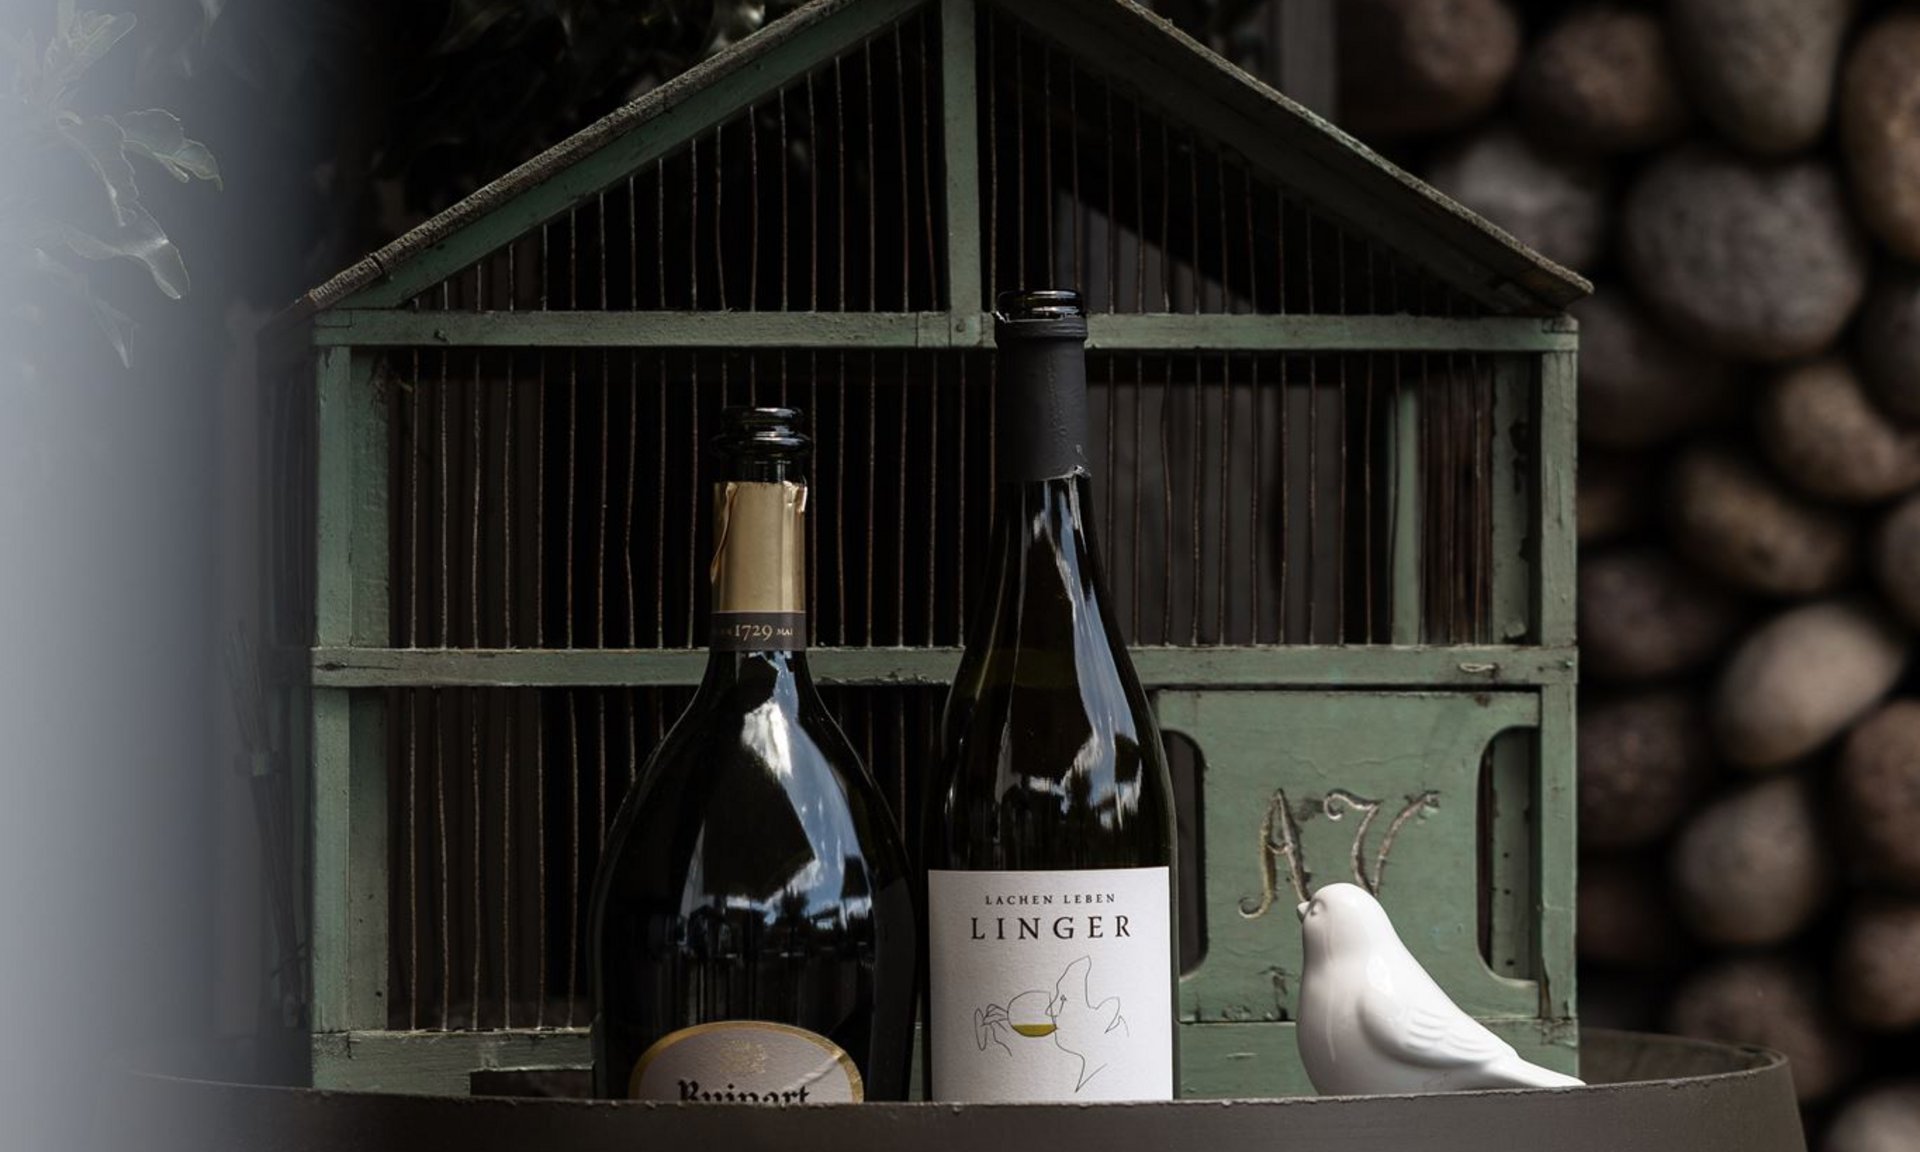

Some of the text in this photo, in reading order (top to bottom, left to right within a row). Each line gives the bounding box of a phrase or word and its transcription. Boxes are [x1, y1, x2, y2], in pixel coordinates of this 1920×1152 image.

[735, 624, 773, 641] 1729
[985, 893, 1115, 905] LACHEN LEBEN
[971, 915, 1131, 940] LINGER
